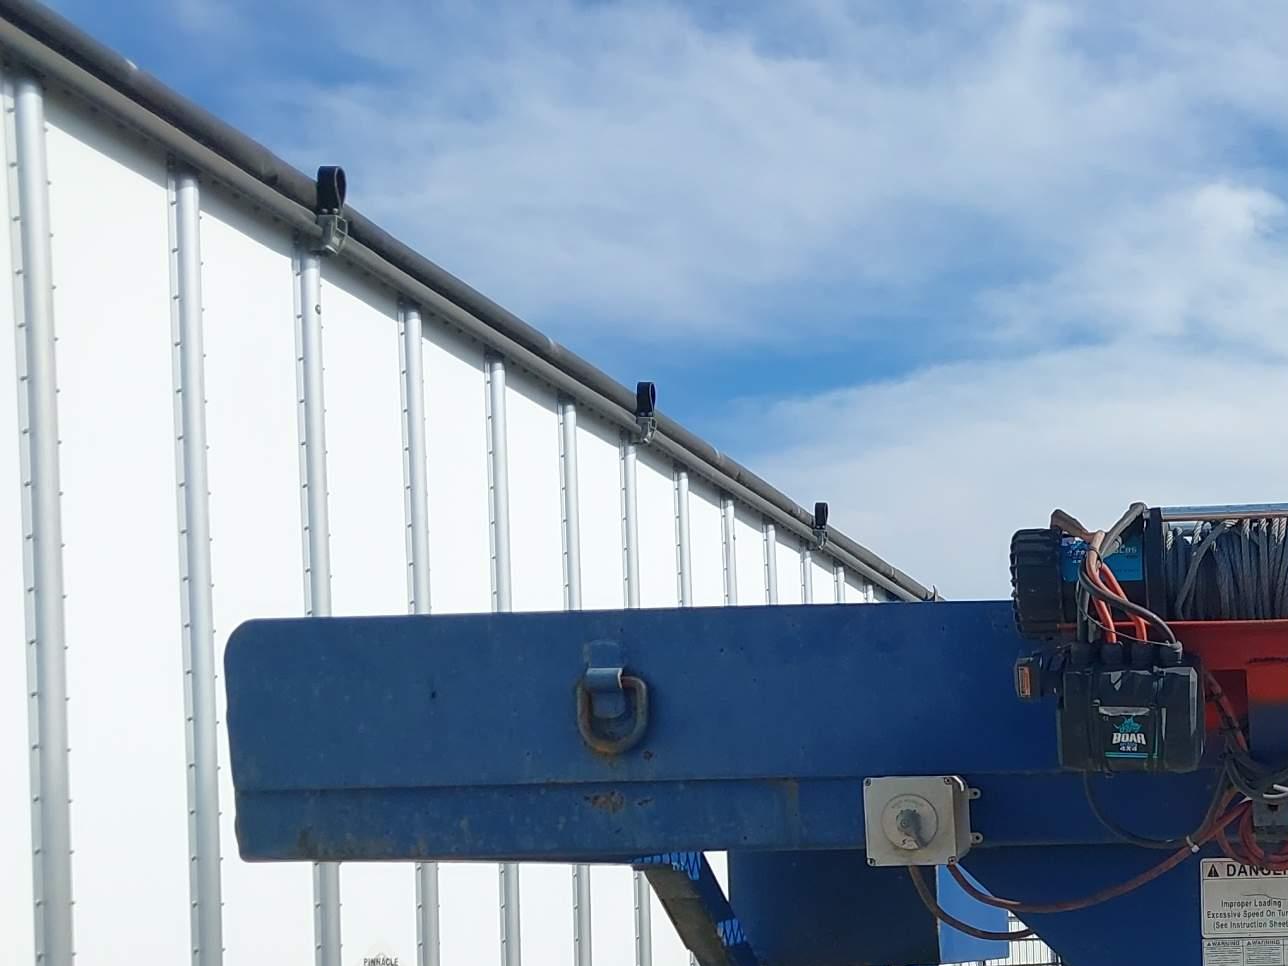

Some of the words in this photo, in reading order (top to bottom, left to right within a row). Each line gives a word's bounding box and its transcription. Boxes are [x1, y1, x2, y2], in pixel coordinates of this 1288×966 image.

[1112, 732, 1146, 745] BOAR
[1221, 900, 1252, 909] Improper
[1254, 899, 1282, 908] Loading
[1207, 911, 1241, 919] Excessive
[1243, 910, 1264, 919] Speed
[1230, 920, 1268, 929] Instruction
[363, 957, 398, 966] PINNACLE
